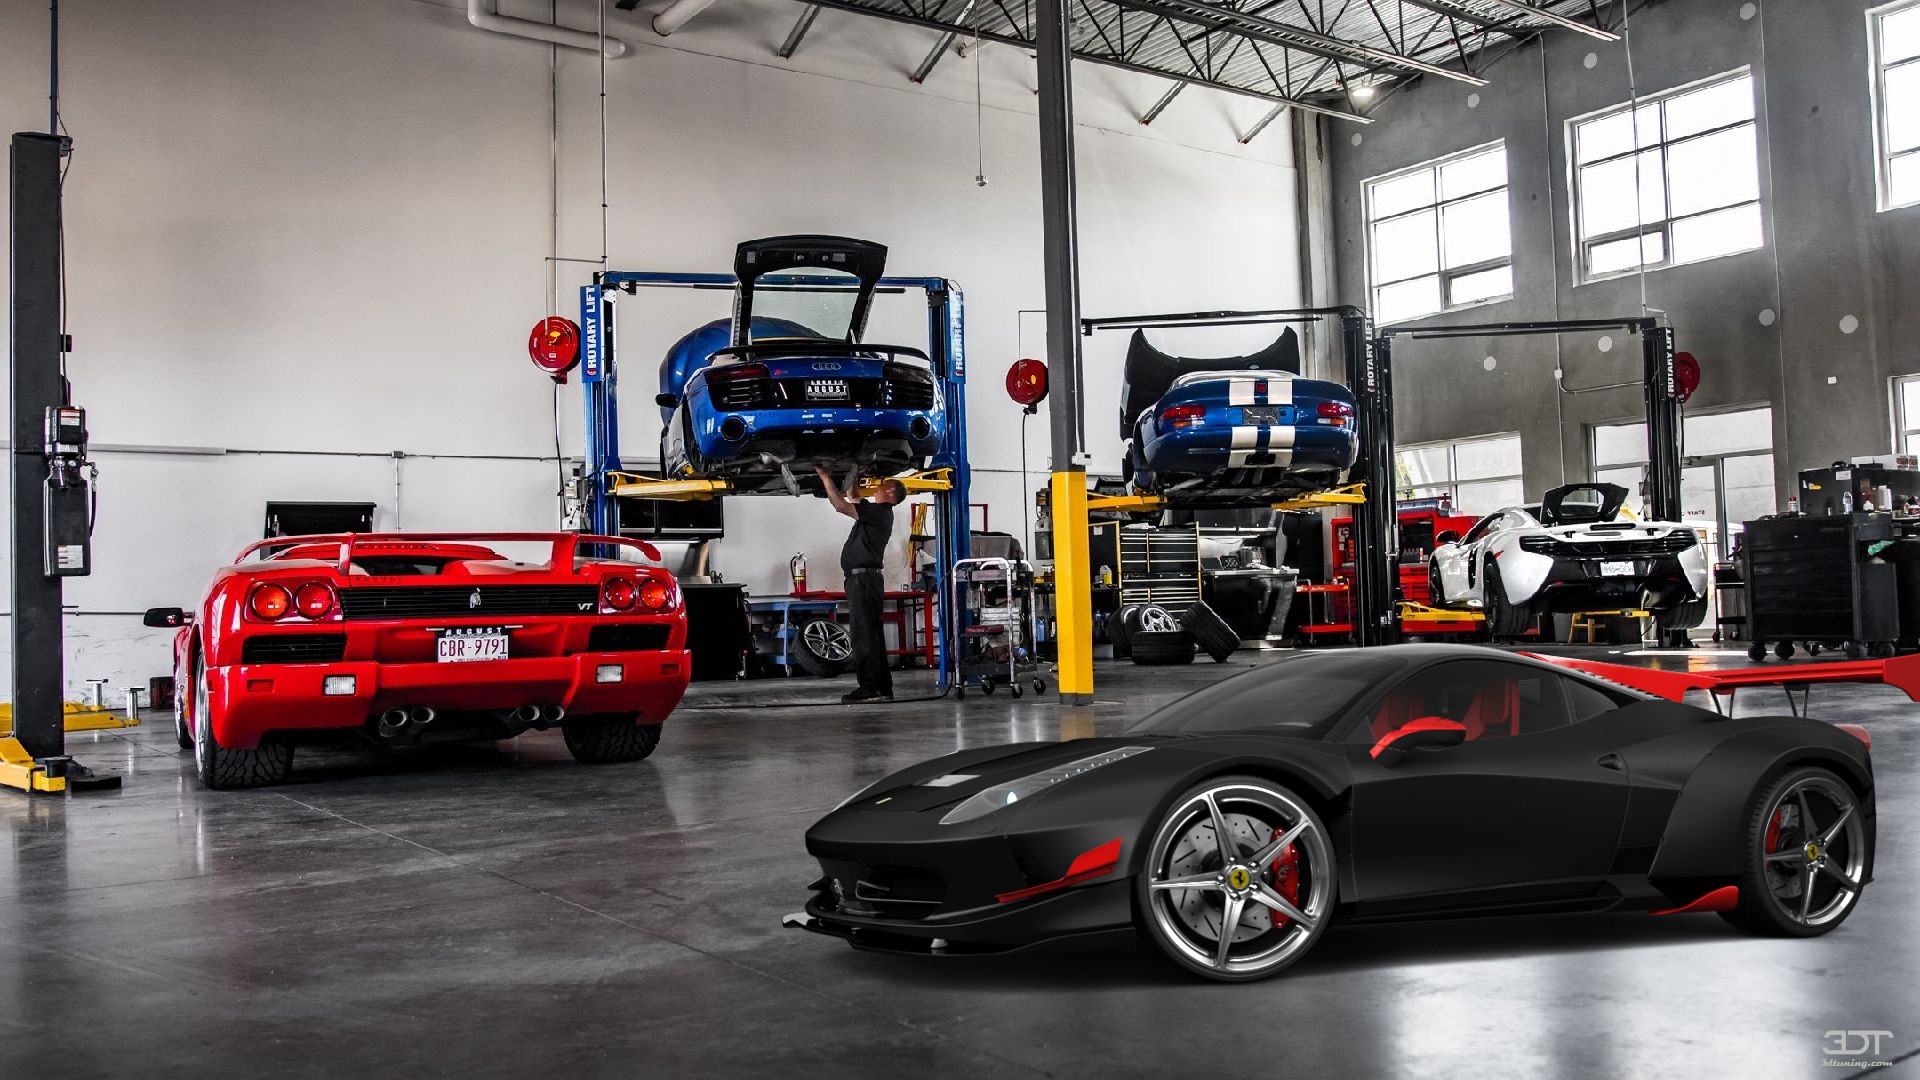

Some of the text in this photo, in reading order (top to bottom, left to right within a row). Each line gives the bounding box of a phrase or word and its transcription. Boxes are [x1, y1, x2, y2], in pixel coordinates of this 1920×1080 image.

[586, 287, 597, 369] ROTARY LIFT
[1366, 343, 1375, 387] ROTARY
[1667, 352, 1675, 393] ROTARY
[807, 385, 847, 393] AUGUST
[446, 627, 502, 636] AUGUST
[440, 639, 507, 656] CBR-9791
